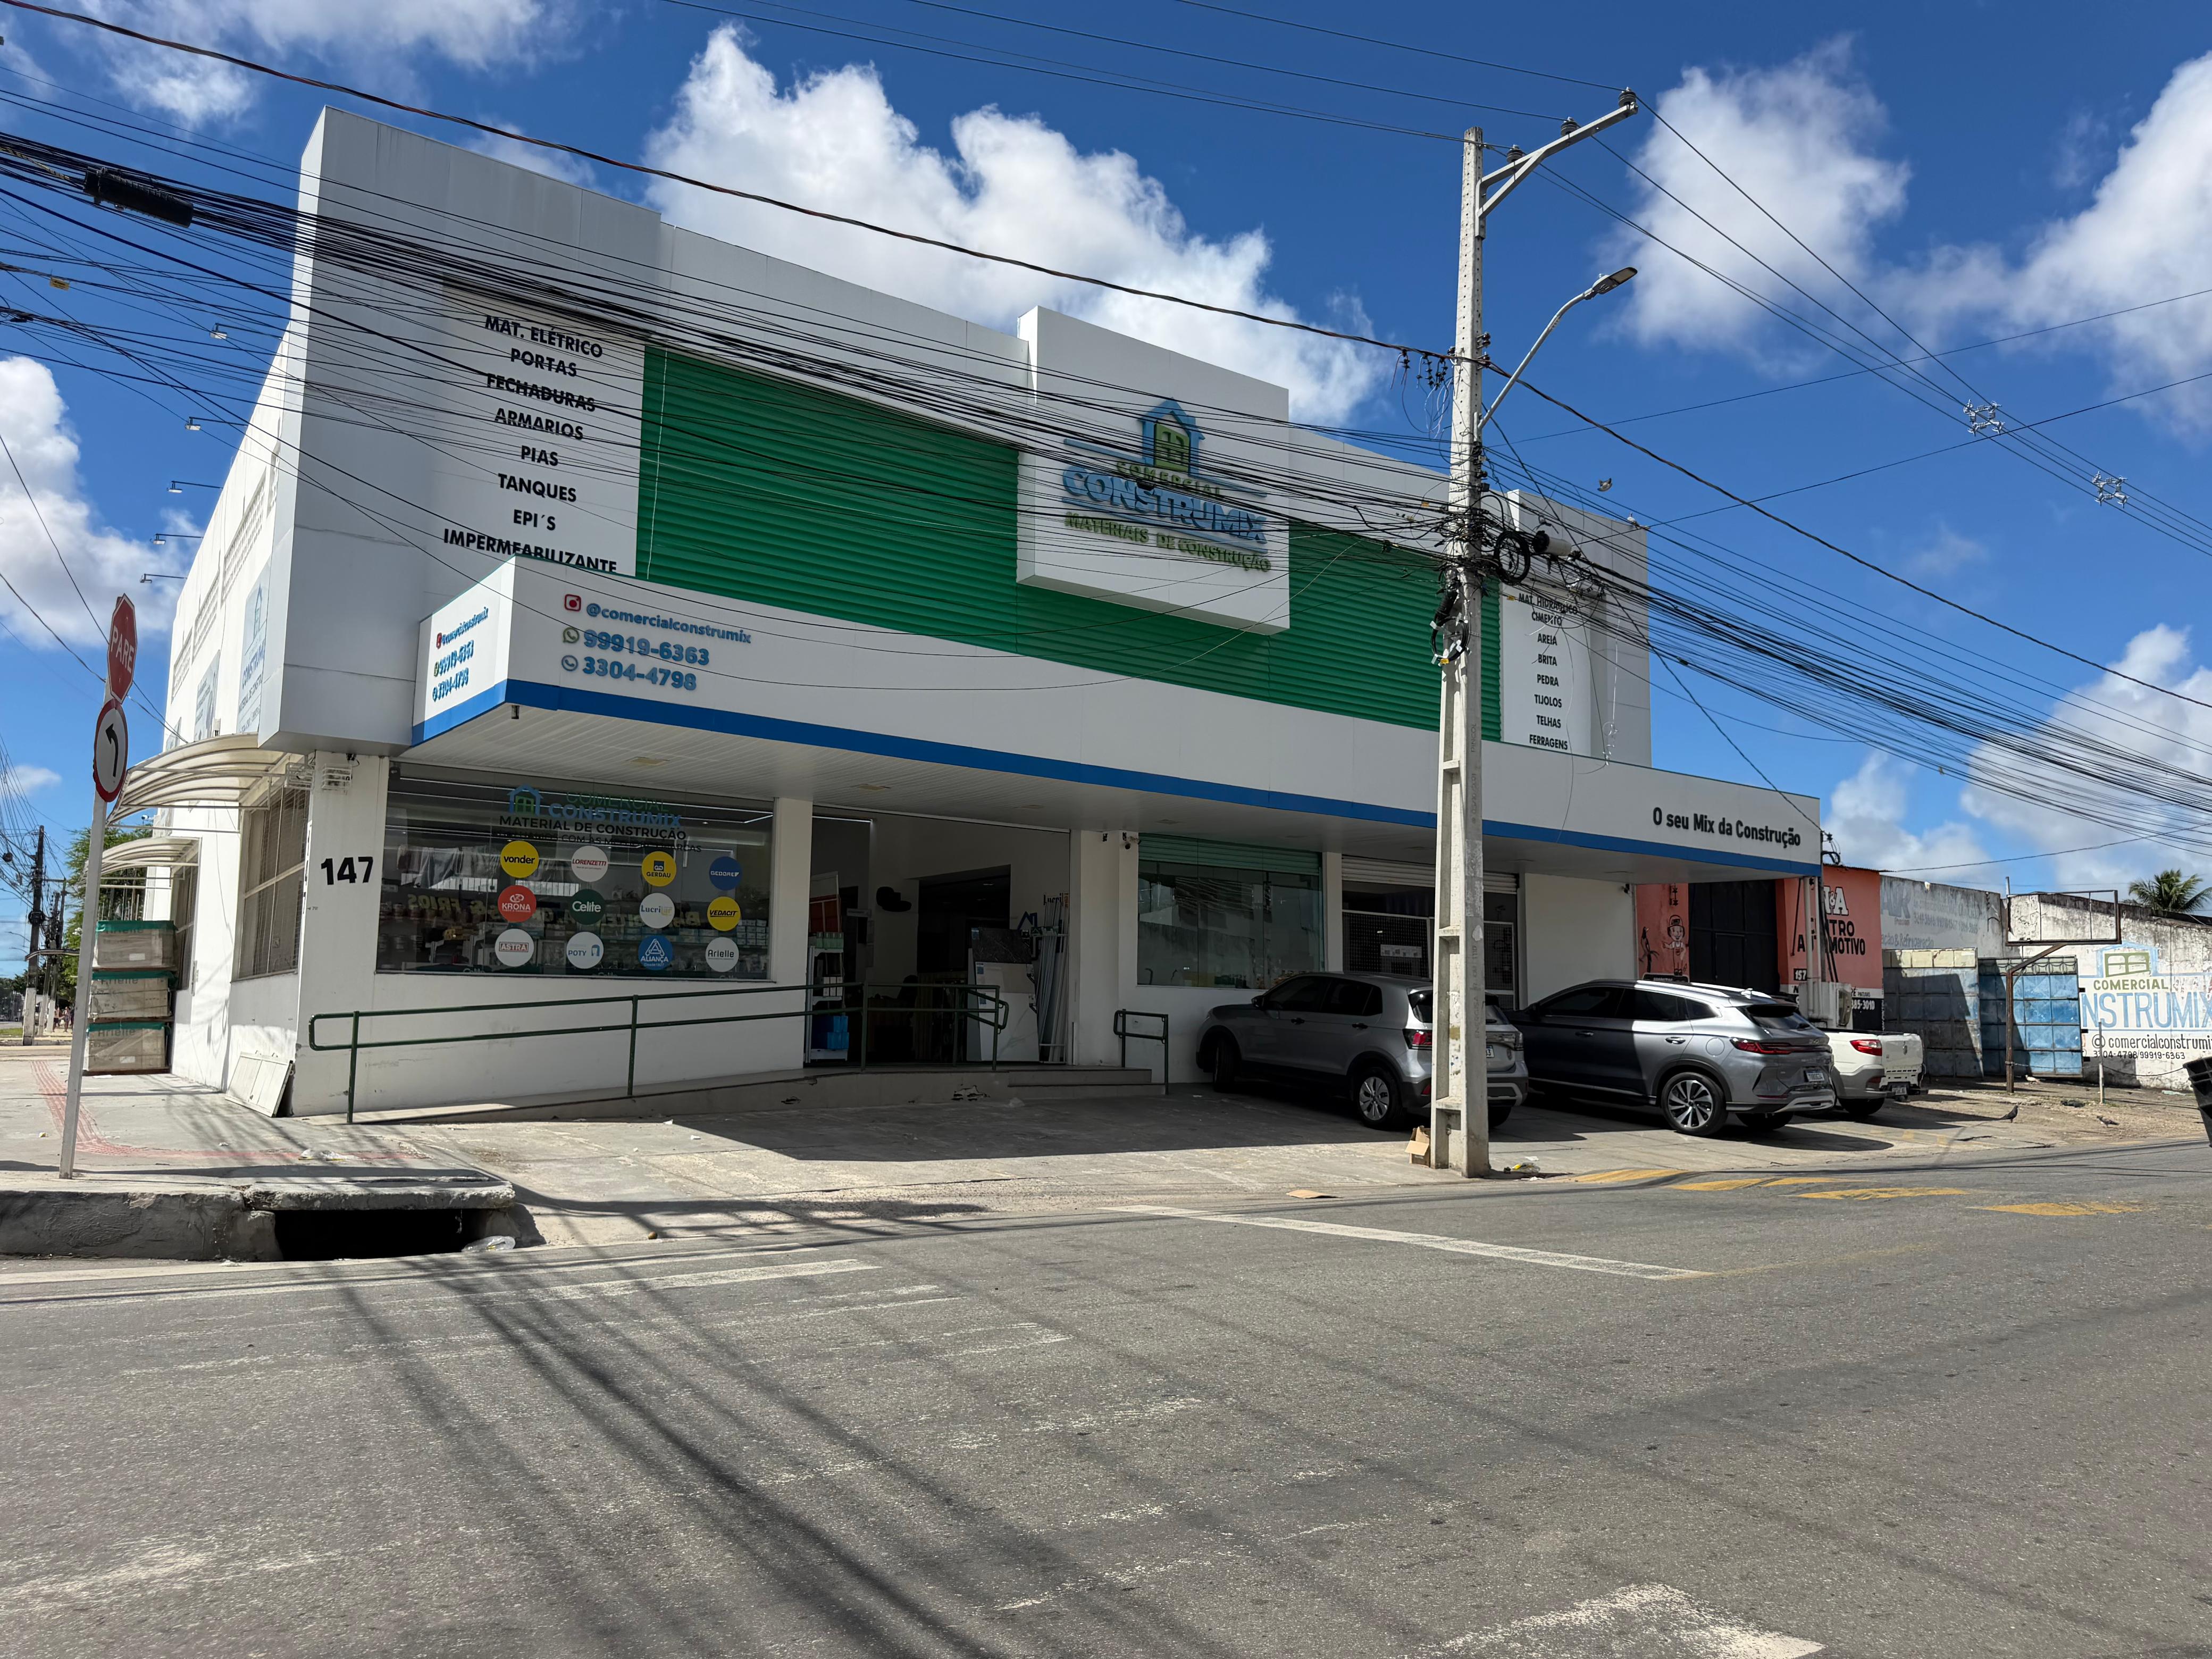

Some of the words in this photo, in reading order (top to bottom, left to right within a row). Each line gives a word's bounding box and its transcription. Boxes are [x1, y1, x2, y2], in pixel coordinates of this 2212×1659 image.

[484, 315, 524, 338] MAT.
[530, 328, 602, 358] ELÉTRICO
[510, 348, 577, 377] PORTAS
[487, 373, 596, 412] FECHADURAS
[495, 408, 583, 440] ARMARIOS
[521, 446, 558, 466] PIAS
[498, 473, 576, 502] TANQUES
[1063, 466, 1268, 544] CONSTRUMIX
[1065, 512, 1150, 543] MATERIAIS
[1156, 532, 1175, 549] DE
[586, 602, 752, 644] @comercialconstrumix
[111, 625, 135, 674] PARE
[583, 629, 710, 666] 99919-6363
[1537, 633, 1557, 646] AREIA
[1538, 653, 1557, 666] BRITA
[582, 656, 697, 691] 3304-4798
[1537, 674, 1559, 686] PEDRA
[1534, 694, 1562, 708] TIJOLOS
[1536, 715, 1561, 728] TELHAS
[1529, 734, 1568, 750] FERRAGENS
[566, 791, 669, 812] COMERCIAL
[548, 802, 682, 827] CONSTRUMIX
[499, 815, 571, 831] MATERIAL
[574, 822, 592, 832] DE
[596, 824, 686, 840] CONSTRUÇÃO
[1653, 807, 1662, 825] O
[1666, 814, 1689, 830] seu
[1694, 813, 1714, 833] Mix
[1719, 817, 1732, 836] da
[1736, 820, 1801, 849] Construção
[321, 857, 374, 885] 147
[504, 855, 535, 864] vonder
[572, 901, 601, 912] Celite
[1795, 970, 1807, 981] 157
[2093, 979, 2169, 990] COMERCIAL
